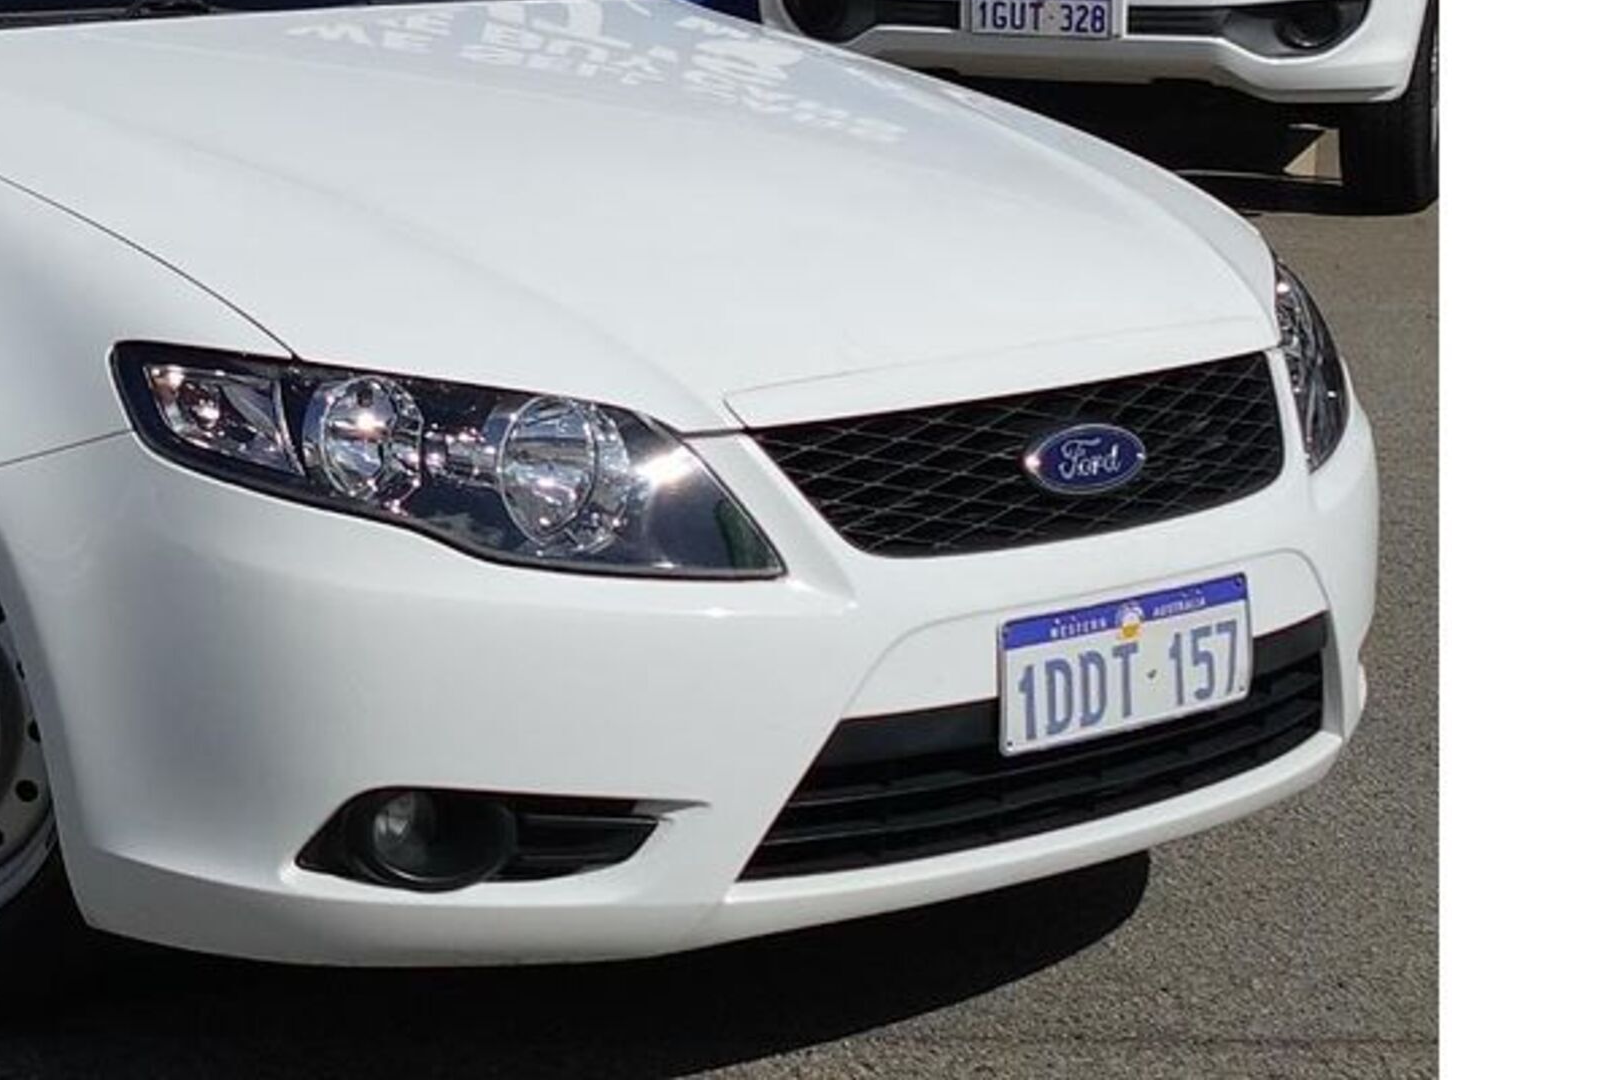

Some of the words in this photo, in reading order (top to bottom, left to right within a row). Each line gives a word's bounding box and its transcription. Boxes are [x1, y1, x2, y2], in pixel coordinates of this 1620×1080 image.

[979, 1, 1044, 30] 1GUT
[1059, 4, 1105, 34] 328
[1058, 437, 1121, 480] Ford
[1018, 641, 1139, 741] 1DDT
[1169, 618, 1238, 707] 157
